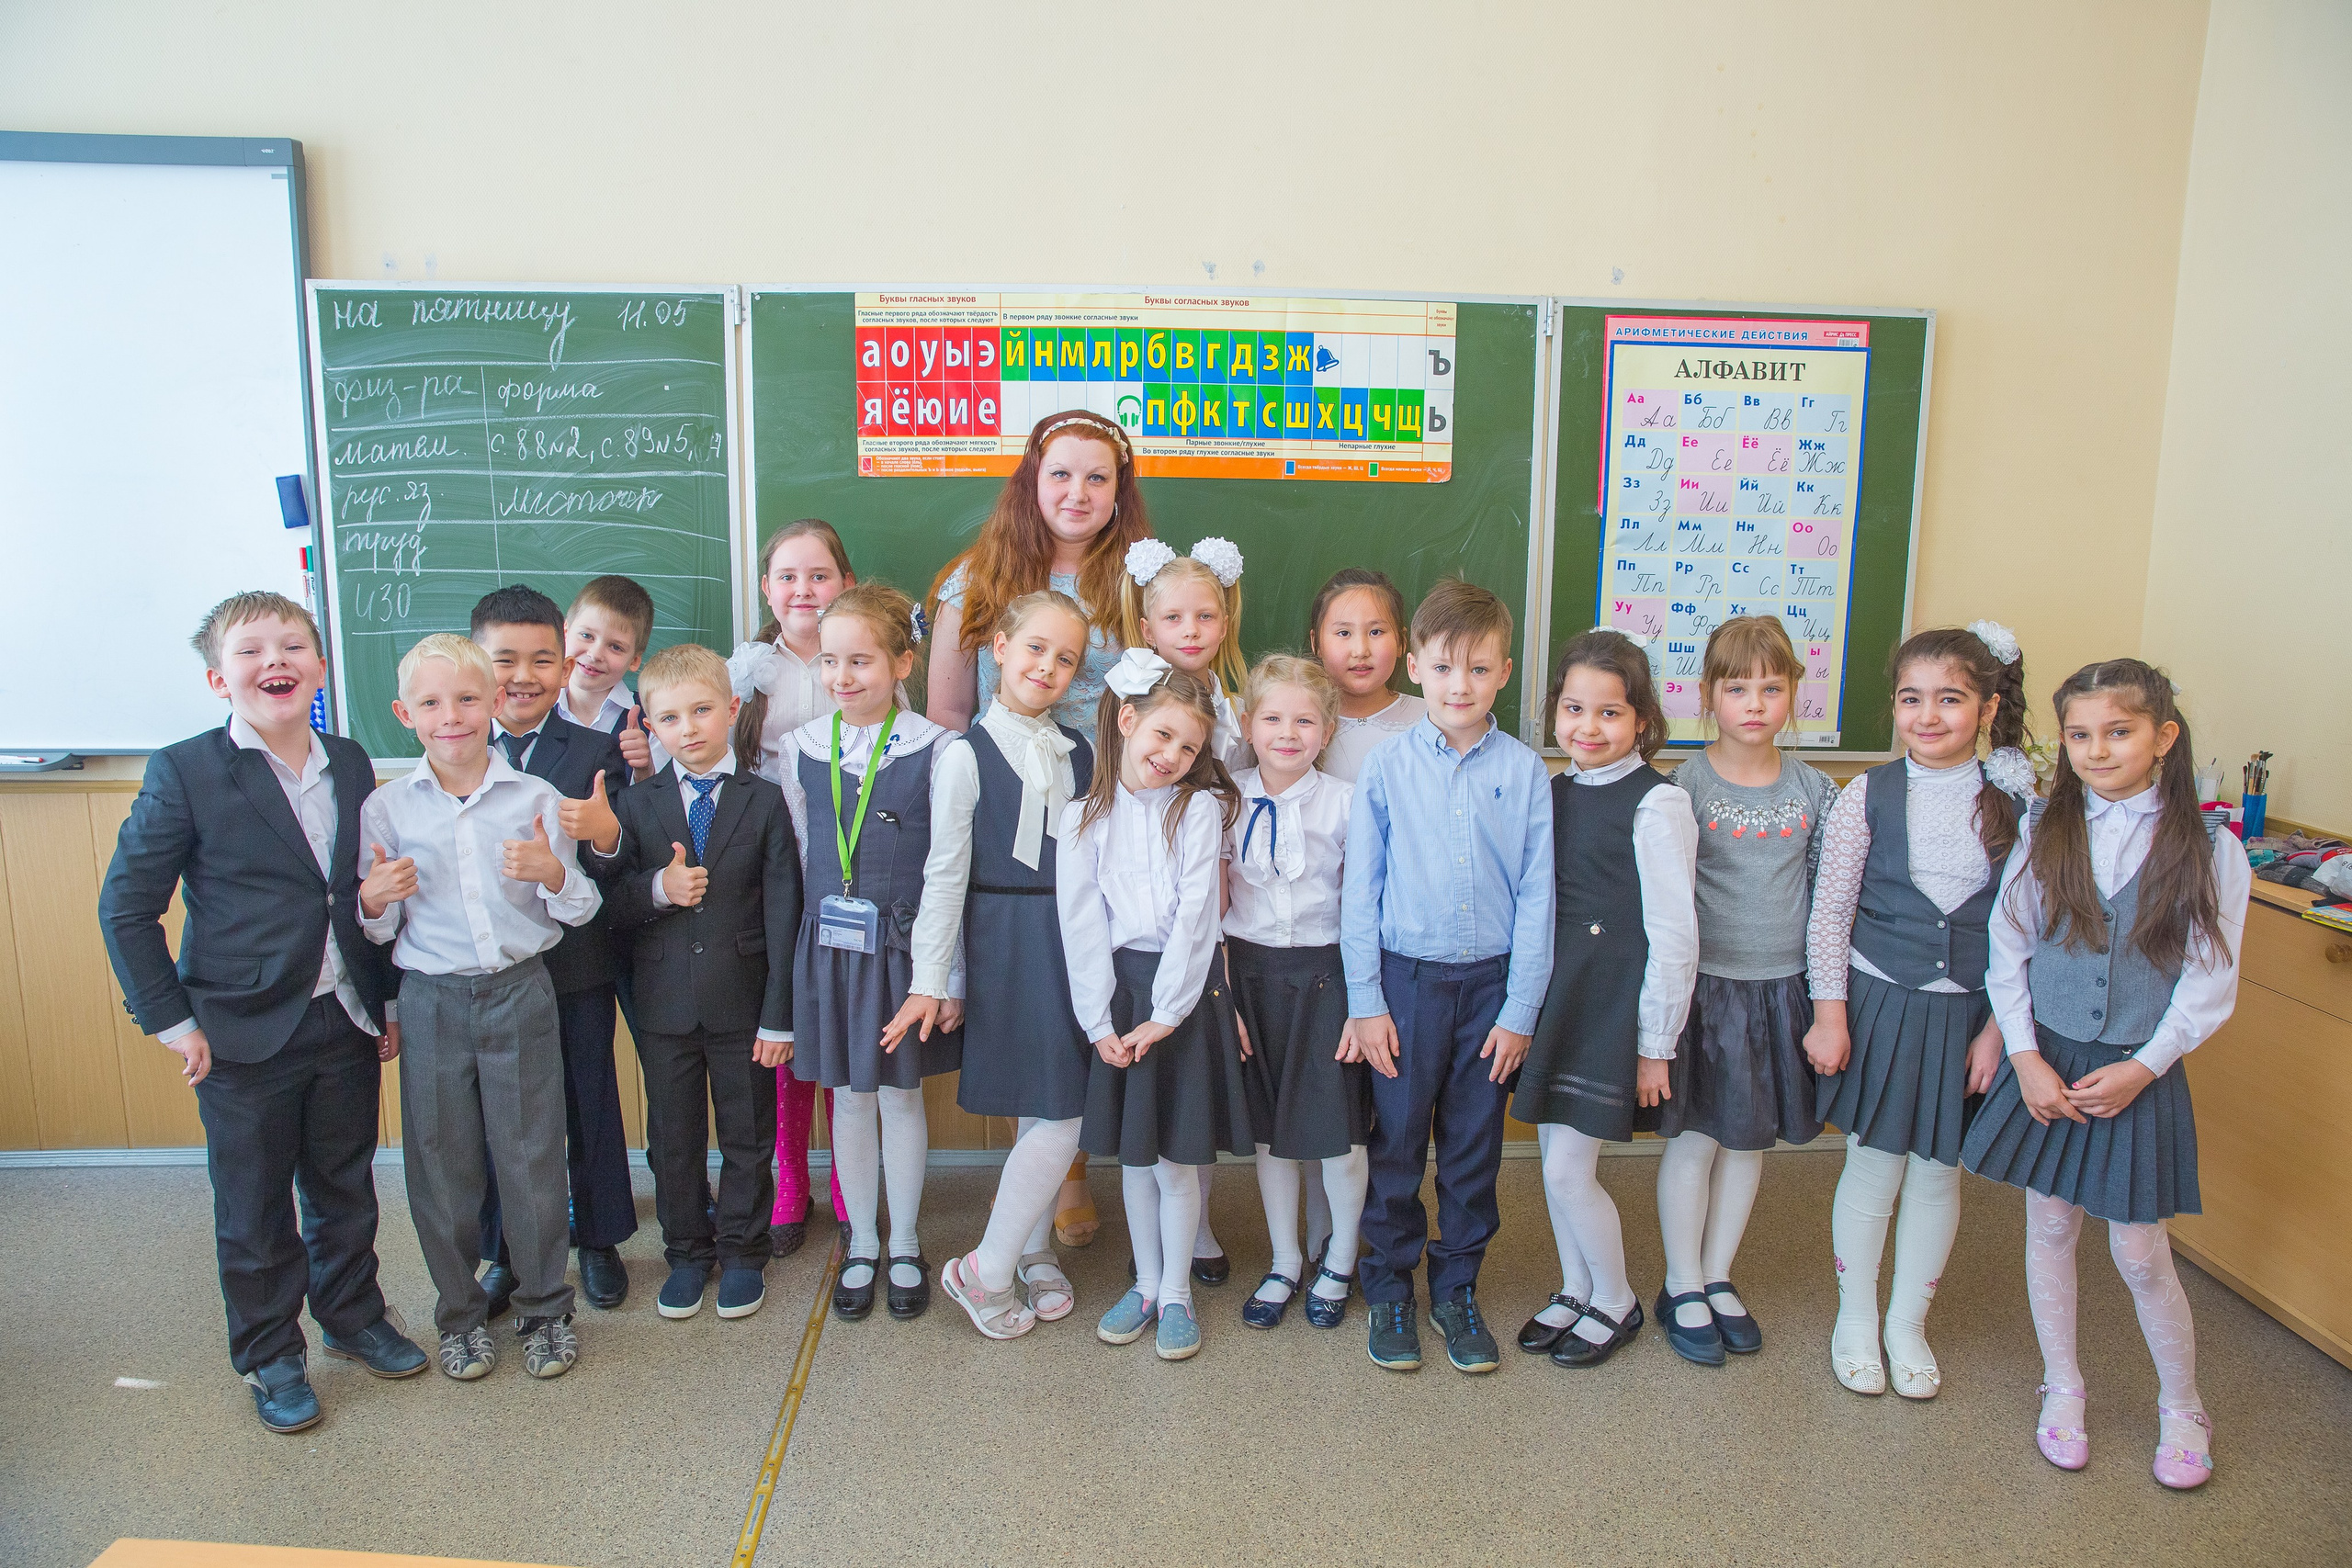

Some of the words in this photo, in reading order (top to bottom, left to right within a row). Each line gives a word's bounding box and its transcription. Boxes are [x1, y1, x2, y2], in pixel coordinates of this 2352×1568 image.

[879, 294, 907, 305] Буквы
[909, 295, 944, 303] гласных
[946, 296, 977, 305] звуков
[1144, 295, 1171, 306] Буквы
[1174, 298, 1218, 306] согласных
[1220, 299, 1250, 309] звуков
[966, 310, 999, 318] твёрдость
[1002, 312, 1008, 321] В
[1615, 327, 1736, 339] АРИФМЕТИЧЕСКИЕ
[1741, 329, 1809, 341] ДЕЙСТВИЯ
[862, 340, 881, 367] а
[890, 340, 910, 367] о
[920, 340, 939, 378] у
[945, 340, 970, 367] ы
[978, 340, 996, 367] э
[1006, 330, 1024, 367] й
[1035, 340, 1054, 367] н
[1060, 341, 1085, 367] м
[1091, 341, 1112, 367] л
[1120, 340, 1139, 378] р
[1147, 332, 1167, 370] б
[1176, 342, 1195, 369] в
[1206, 343, 1221, 369] г
[1230, 344, 1253, 378] д
[1262, 344, 1280, 371] з
[1286, 344, 1311, 372] ж
[1674, 358, 1806, 381] АЛФАВИТ
[498, 378, 605, 412] форма
[1627, 393, 1645, 404] Аа
[1684, 393, 1702, 405] Бб
[1744, 396, 1760, 407] Вв
[1802, 397, 1815, 408] Гг
[864, 397, 883, 425] я
[891, 387, 910, 425] ё
[917, 397, 943, 425] ю
[949, 397, 968, 425] и
[978, 398, 996, 425] е
[1185, 439, 1212, 447] Парные
[1213, 440, 1266, 448] звонкие/глухие
[1339, 442, 1373, 451] Непарные
[1624, 434, 1646, 449] Дд
[1682, 436, 1699, 447] Ее
[1742, 435, 1758, 449] Ёё
[1798, 439, 1826, 451] Жж
[1623, 478, 1640, 488] Зз
[1680, 479, 1700, 490] Ии
[1740, 478, 1758, 491] Йй
[1797, 482, 1815, 492] Кк
[1620, 519, 1640, 529] Лл
[1678, 520, 1702, 531] Мм
[1736, 521, 1755, 532] Нн
[1792, 522, 1813, 534] Оо
[1617, 560, 1636, 570] Пп
[1675, 561, 1693, 575] Рр
[1732, 562, 1749, 574] Сс
[1791, 564, 1804, 575] Тт
[1615, 601, 1633, 615] Уу
[1671, 602, 1696, 615] Фф
[1730, 604, 1747, 615] Хх
[1787, 605, 1806, 617] Цц
[1668, 642, 1694, 653] Шш
[1666, 682, 1682, 693] Ээ
